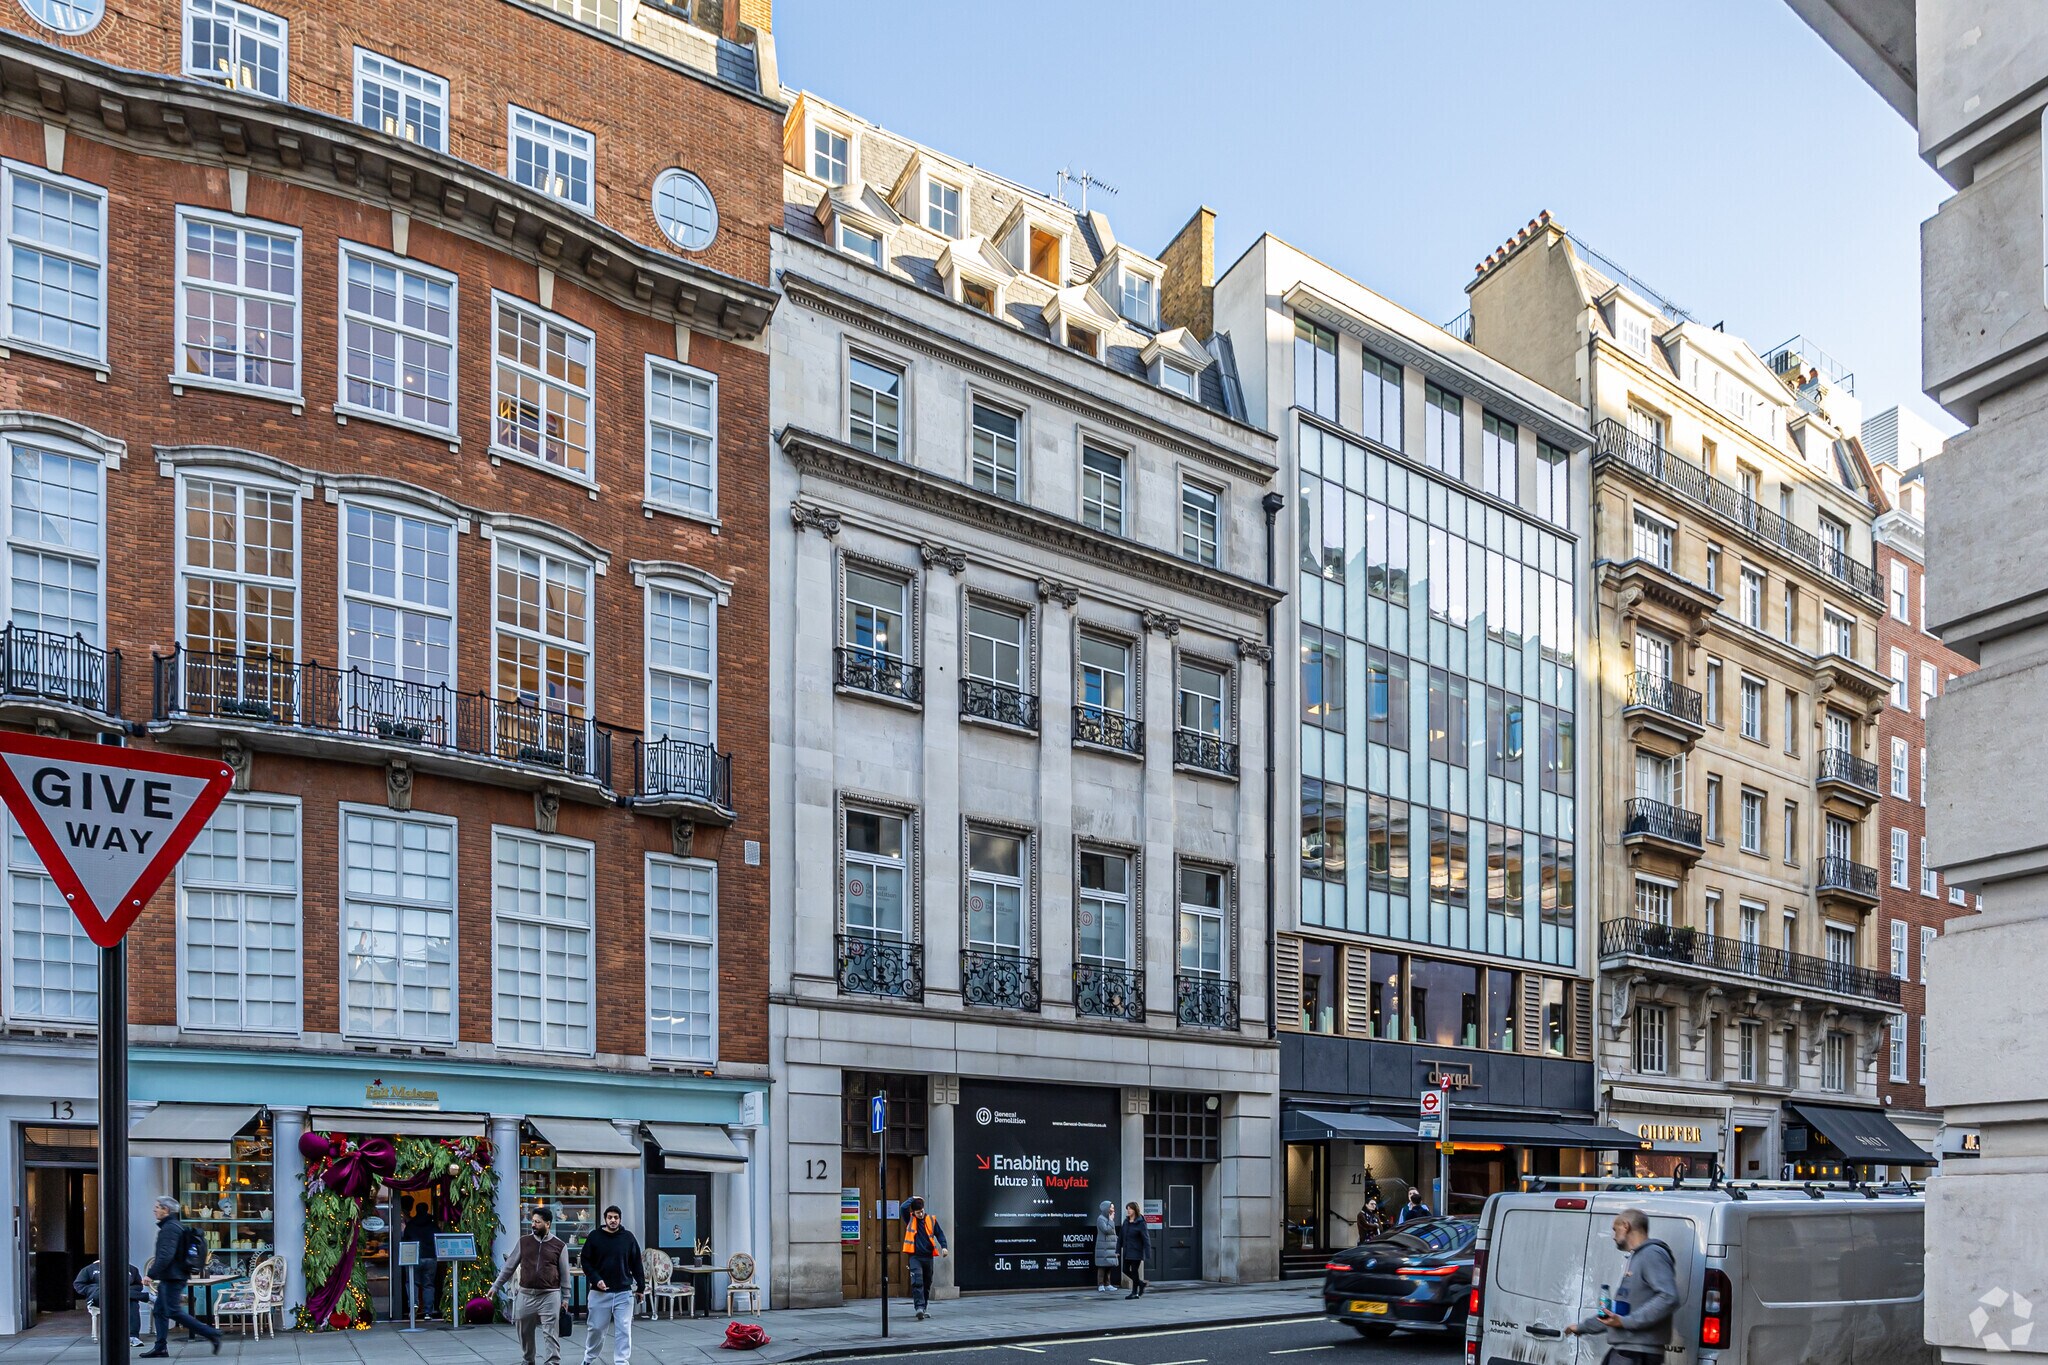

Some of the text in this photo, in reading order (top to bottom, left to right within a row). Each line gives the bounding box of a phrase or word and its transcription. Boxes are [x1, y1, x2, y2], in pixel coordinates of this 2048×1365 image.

[32, 767, 173, 820] GIVE
[65, 822, 153, 854] WAY
[1441, 1076, 1448, 1088] Z
[365, 1085, 438, 1100] Fait Maison
[50, 1101, 74, 1120] 13
[806, 1160, 828, 1180] 12
[994, 1154, 1089, 1175] Enabling the
[994, 1175, 1089, 1190] future in Mayfair
[1351, 1173, 1362, 1185] 11
[995, 1258, 1011, 1270] dla
